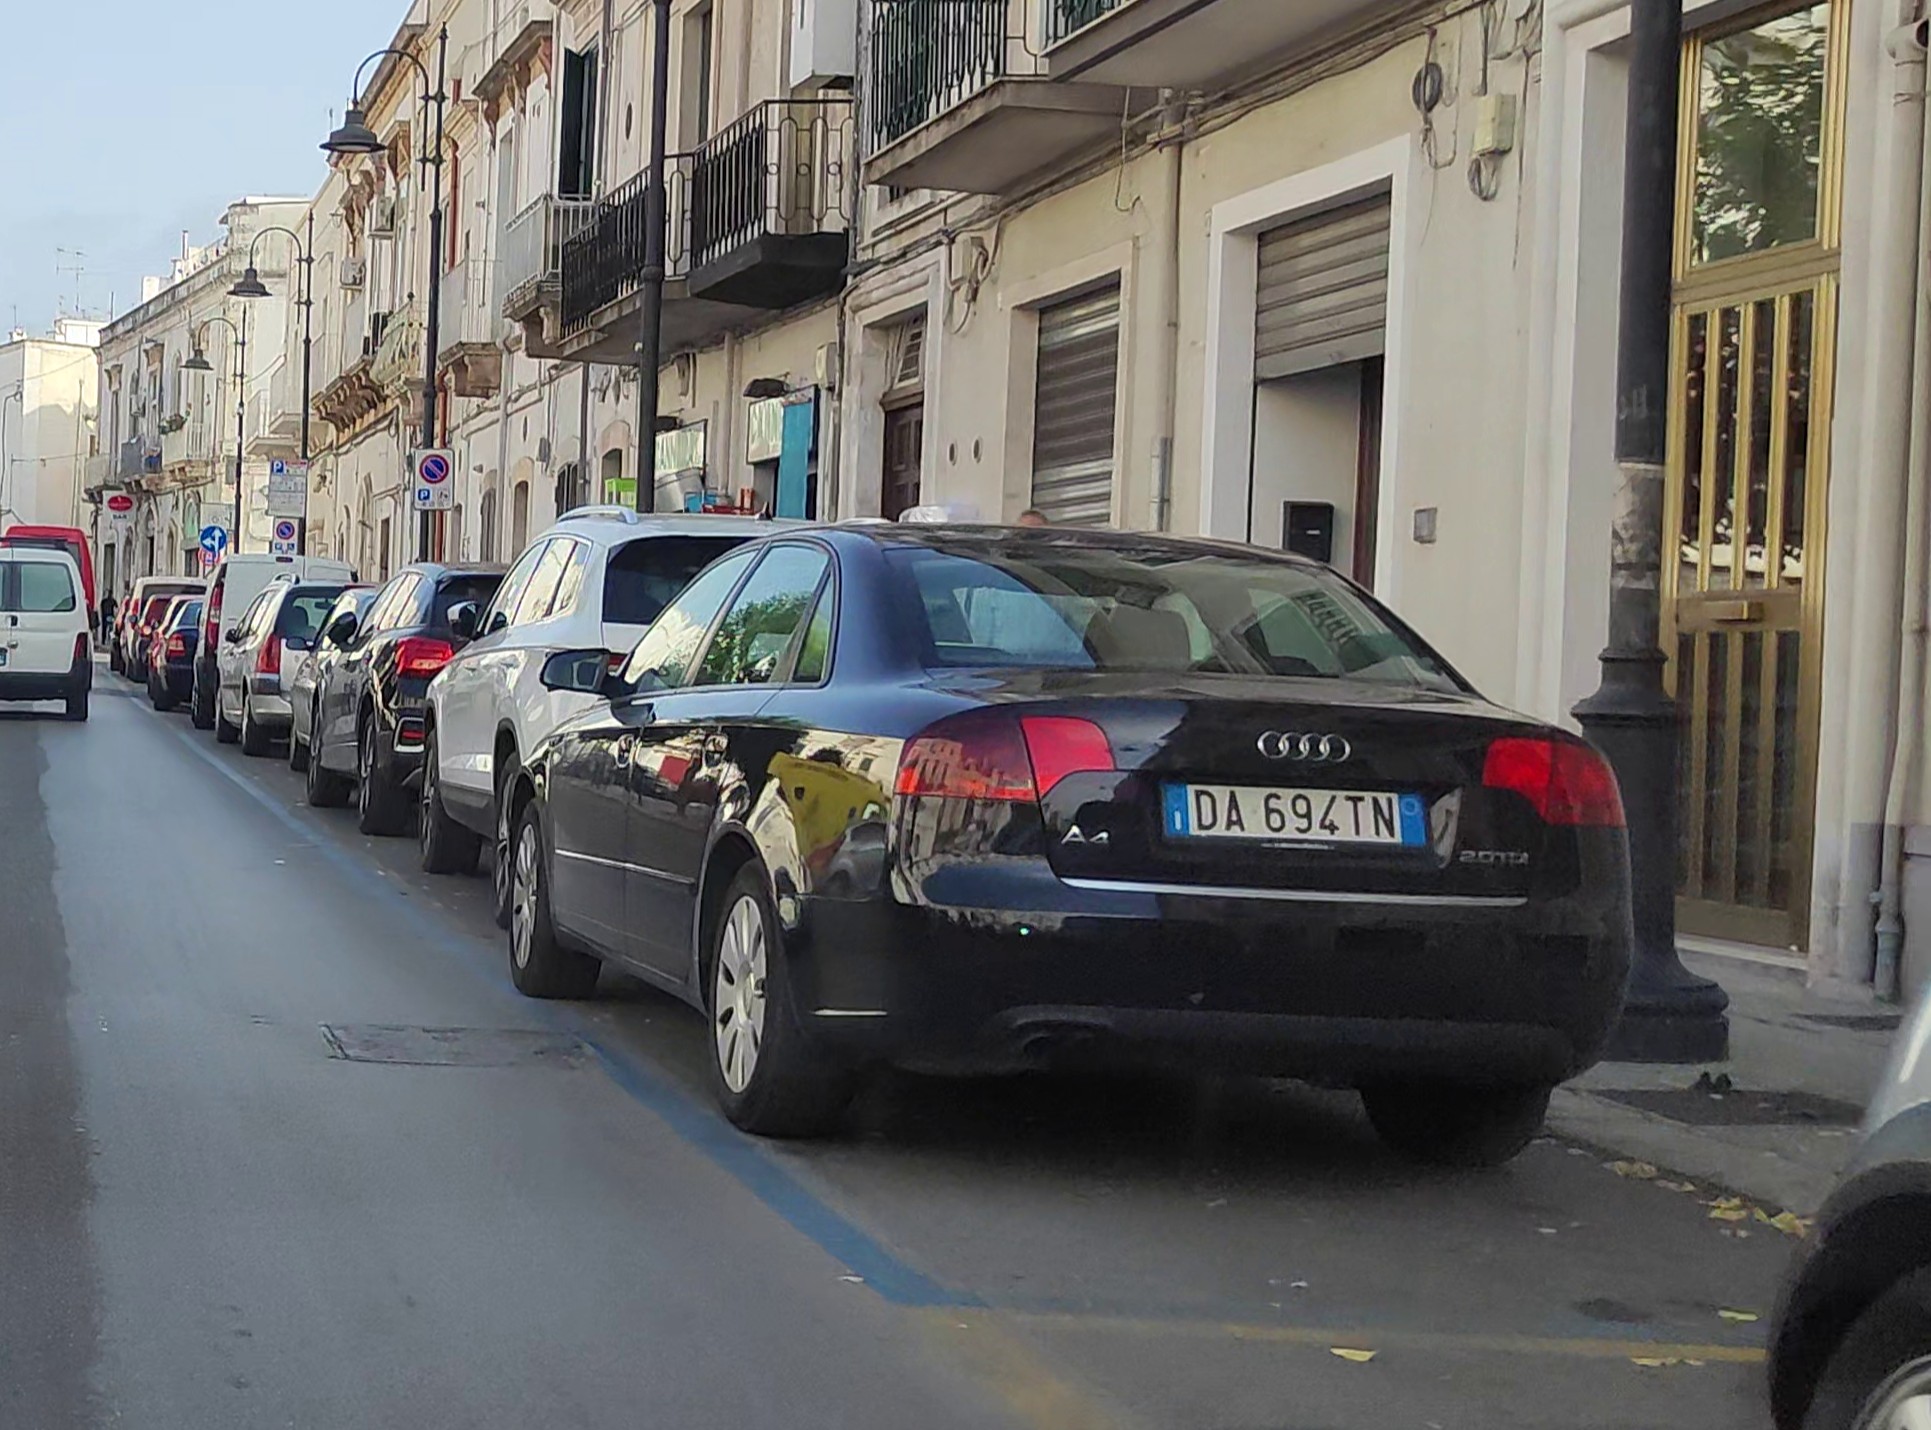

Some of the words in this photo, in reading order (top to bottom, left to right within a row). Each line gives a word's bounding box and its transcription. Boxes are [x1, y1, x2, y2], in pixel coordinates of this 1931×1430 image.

[1194, 789, 1245, 833] DA
[1263, 793, 1396, 839] 694TN
[1061, 824, 1109, 845] A4
